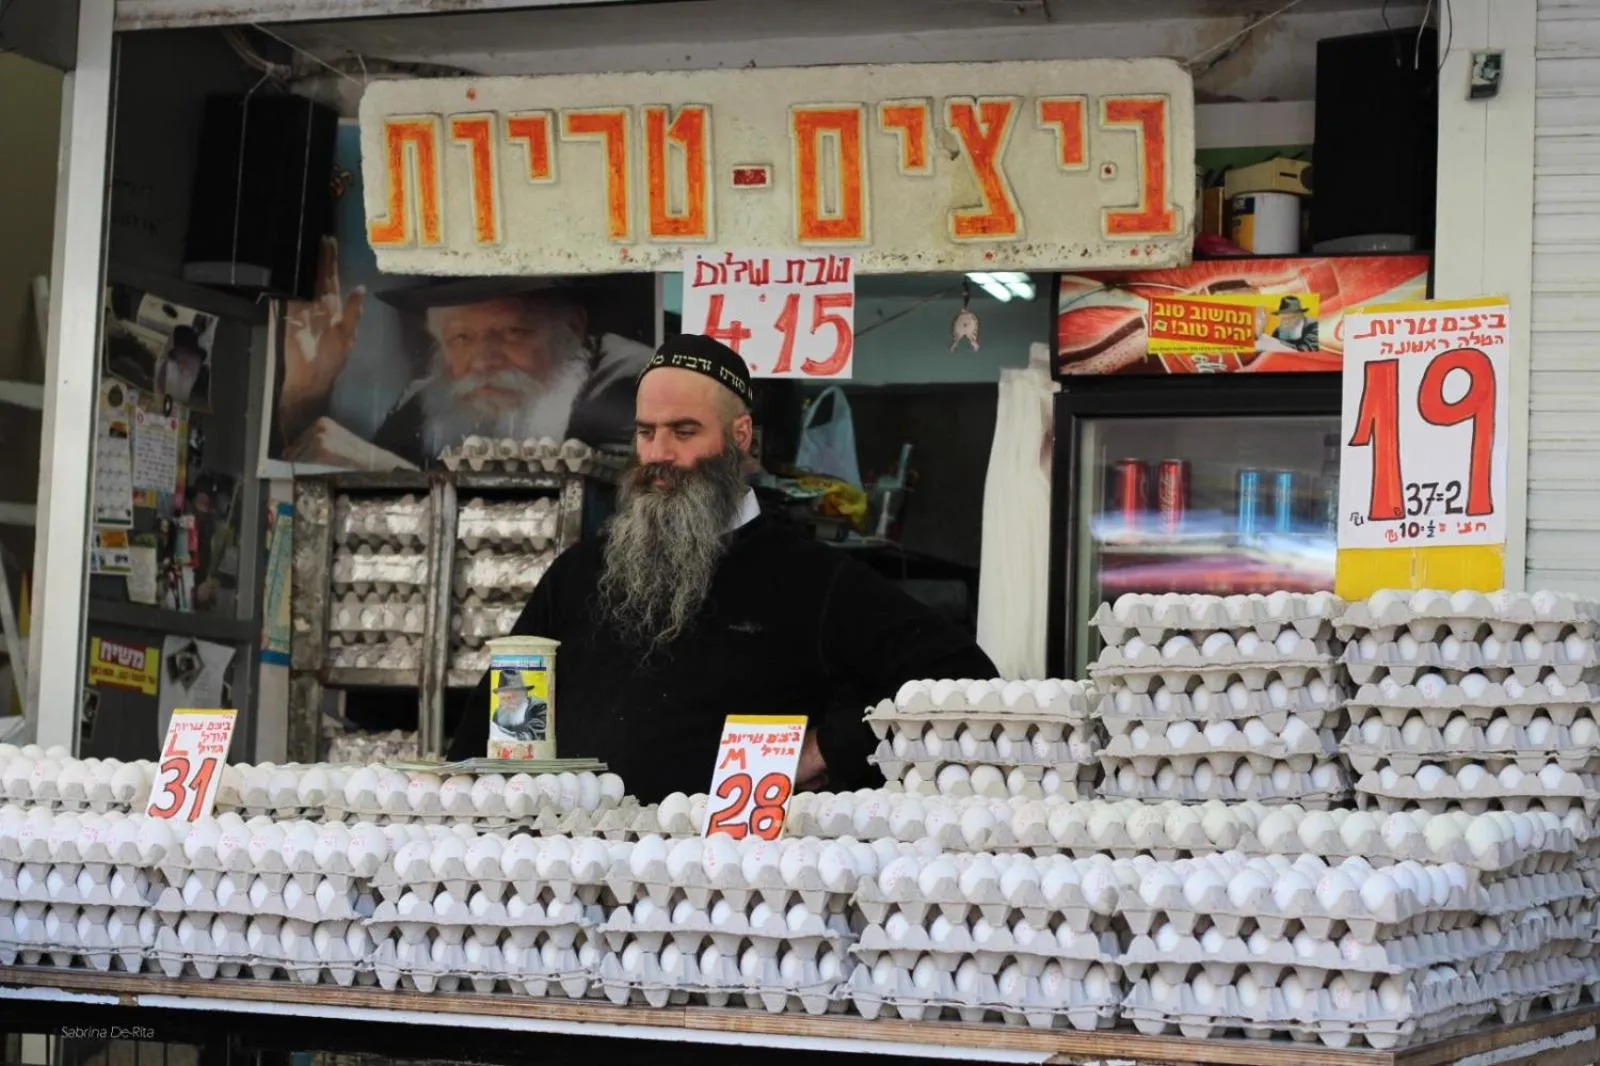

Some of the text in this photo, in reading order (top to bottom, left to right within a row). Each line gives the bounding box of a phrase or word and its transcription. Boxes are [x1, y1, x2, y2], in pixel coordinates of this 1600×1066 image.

[692, 252, 850, 287] שבת שלום
[1154, 303, 1252, 325] תחשוב טוב
[1353, 313, 1507, 339] ביצים טריות
[1171, 320, 1252, 341] יהיה טוב!
[1380, 338, 1449, 354] ראשונה
[1348, 347, 1496, 521] 19
[101, 641, 145, 669] משיח
[164, 733, 189, 758] L
[719, 748, 747, 770] M
[148, 757, 217, 822] 31
[705, 772, 792, 841] 28
